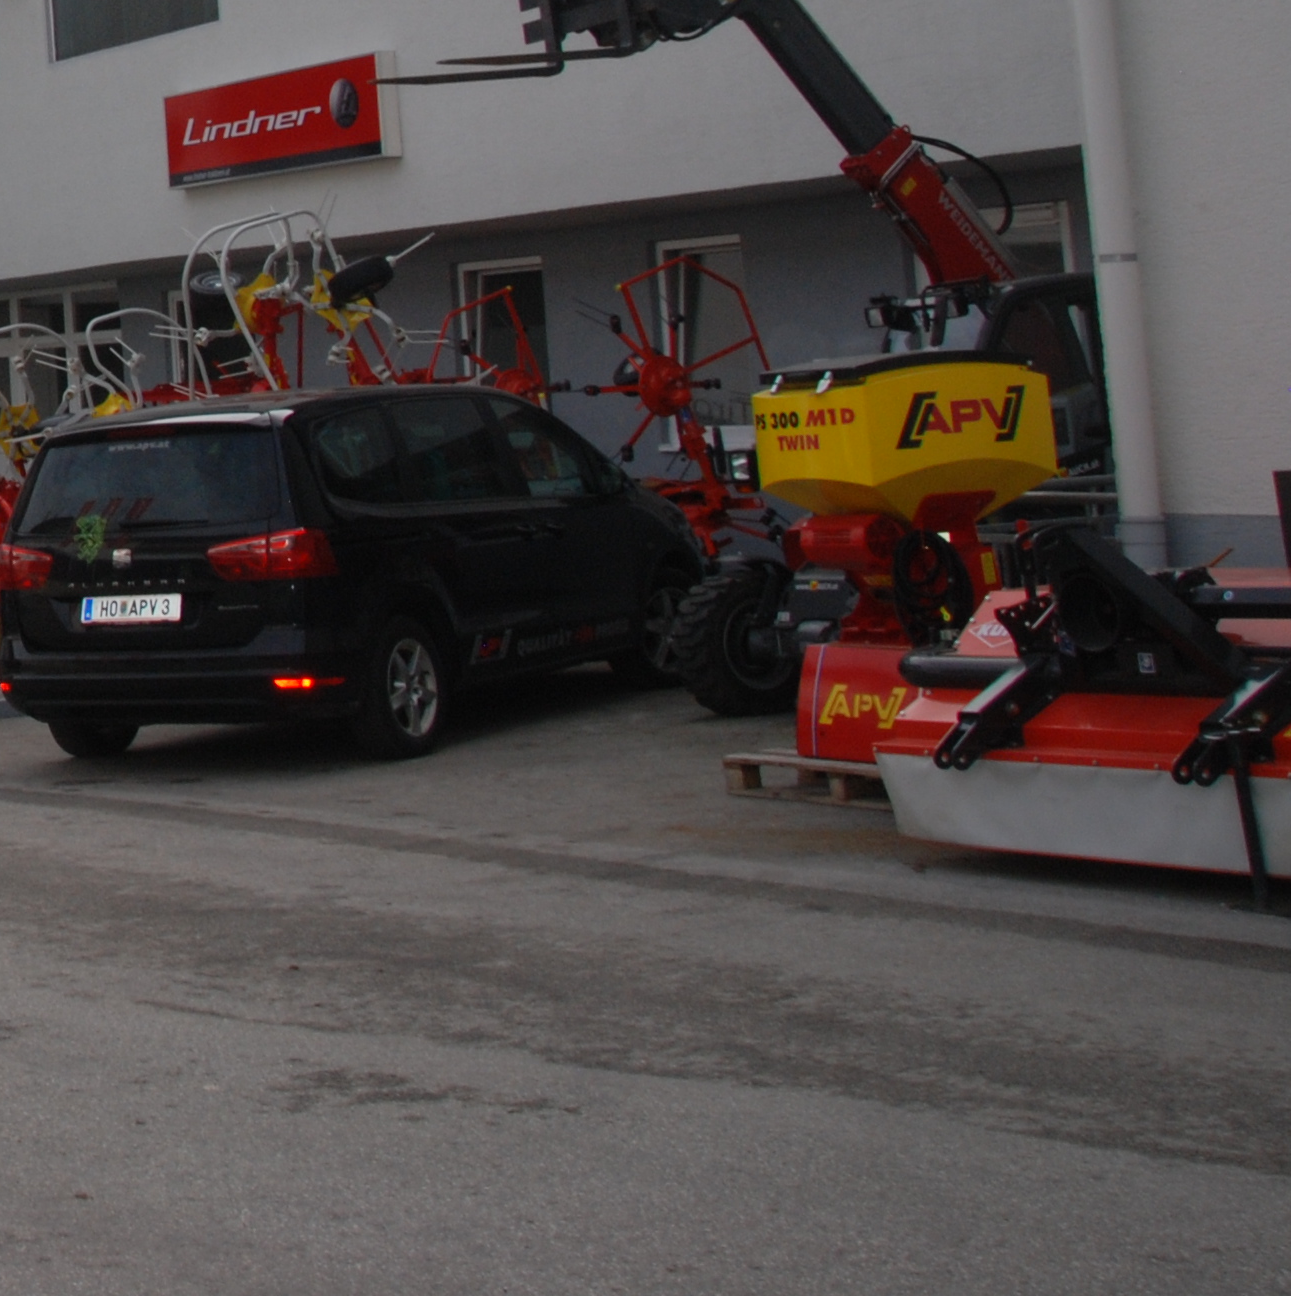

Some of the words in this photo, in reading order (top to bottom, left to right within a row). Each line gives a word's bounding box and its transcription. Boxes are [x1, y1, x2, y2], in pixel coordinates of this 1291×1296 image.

[182, 105, 322, 146] Lindner
[755, 413, 766, 430] PS
[770, 411, 799, 428] 300
[777, 434, 820, 451] TWIN
[100, 600, 118, 617] HO
[128, 598, 158, 616] APV
[161, 599, 170, 615] 3
